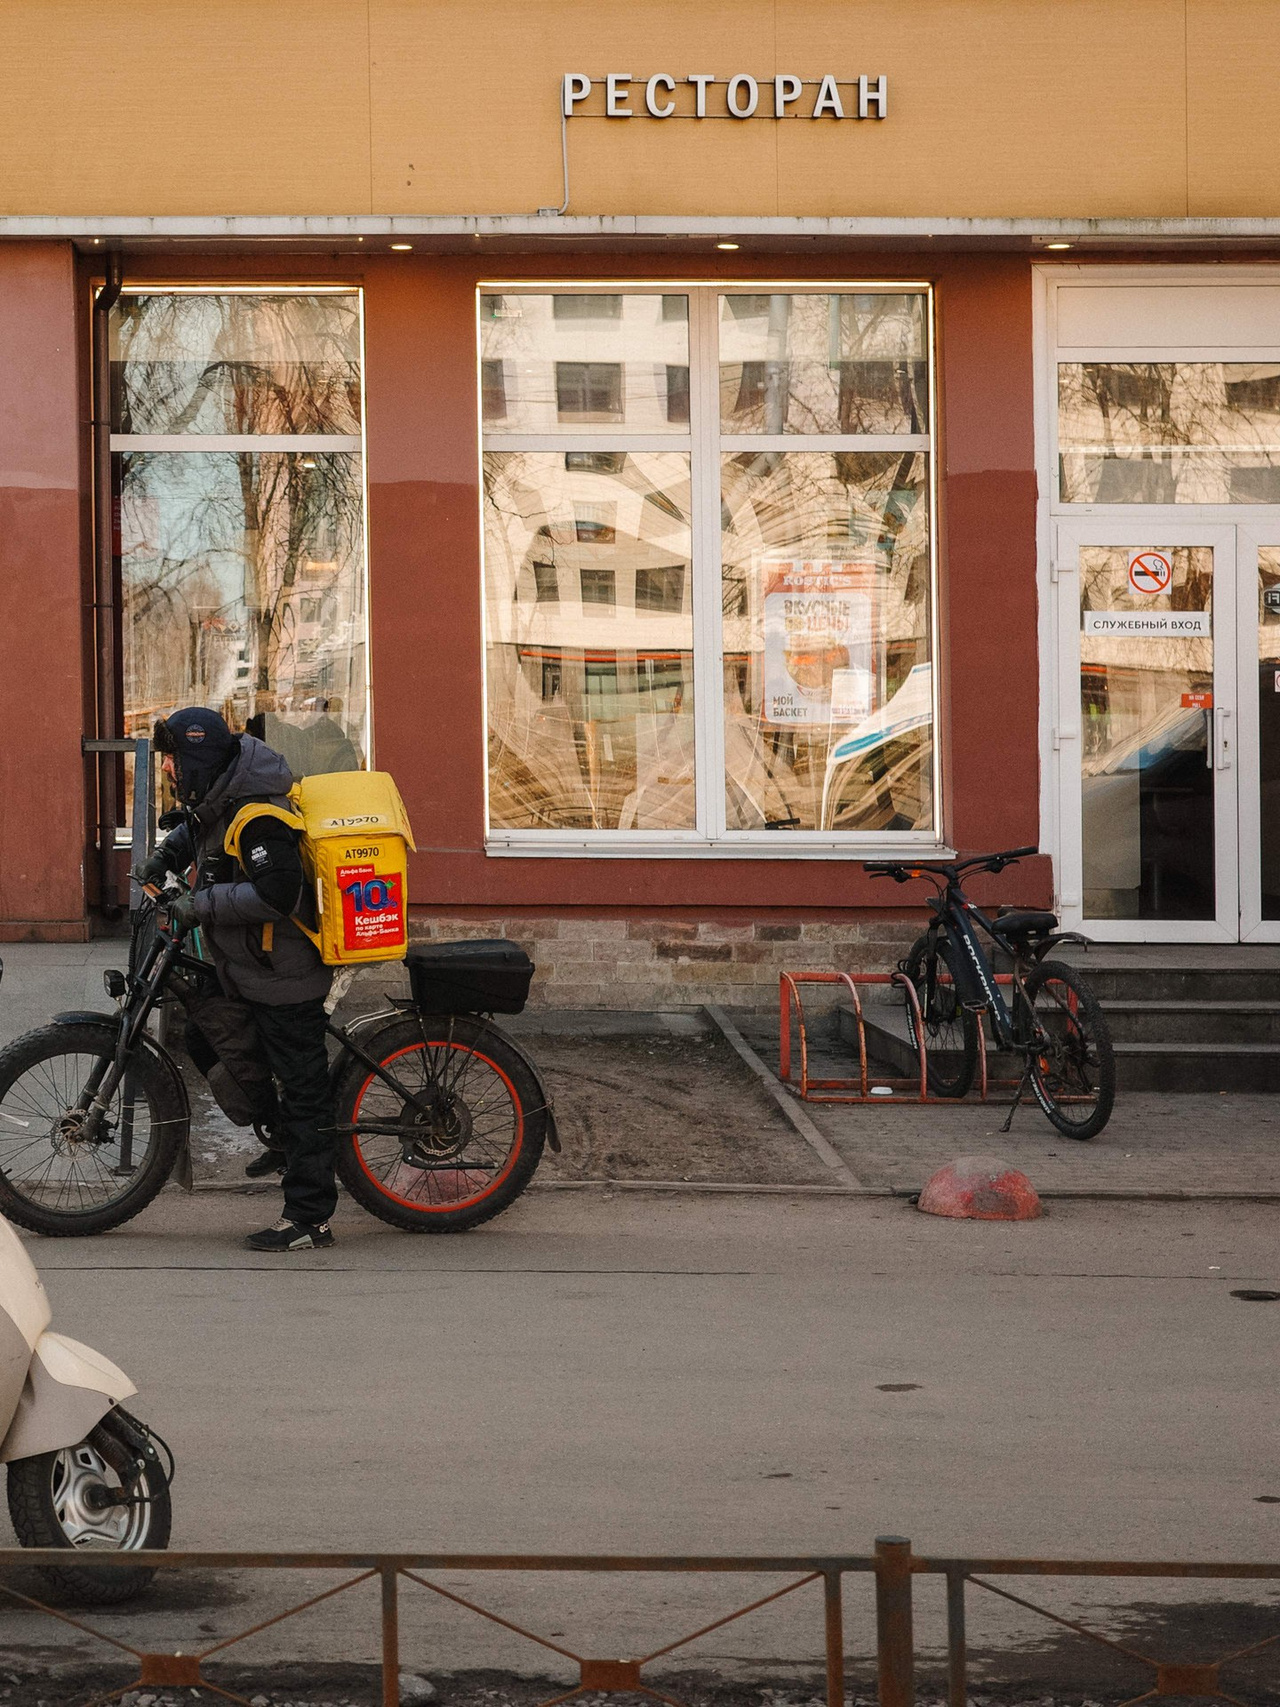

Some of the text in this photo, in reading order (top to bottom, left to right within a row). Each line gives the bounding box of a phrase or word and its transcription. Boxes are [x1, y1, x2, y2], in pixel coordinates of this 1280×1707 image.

[564, 73, 888, 119] РЕСТОРАН
[1093, 618, 1202, 630] СЛУЖЕБНЫЙ ВХОД
[773, 693, 794, 706] МОЙ
[773, 708, 808, 718] БАСКЕТ
[345, 846, 380, 860] AT9970
[355, 913, 399, 926] Кешбэк
[365, 923, 383, 931] карте
[963, 934, 1001, 1021] ROCKRIDR
